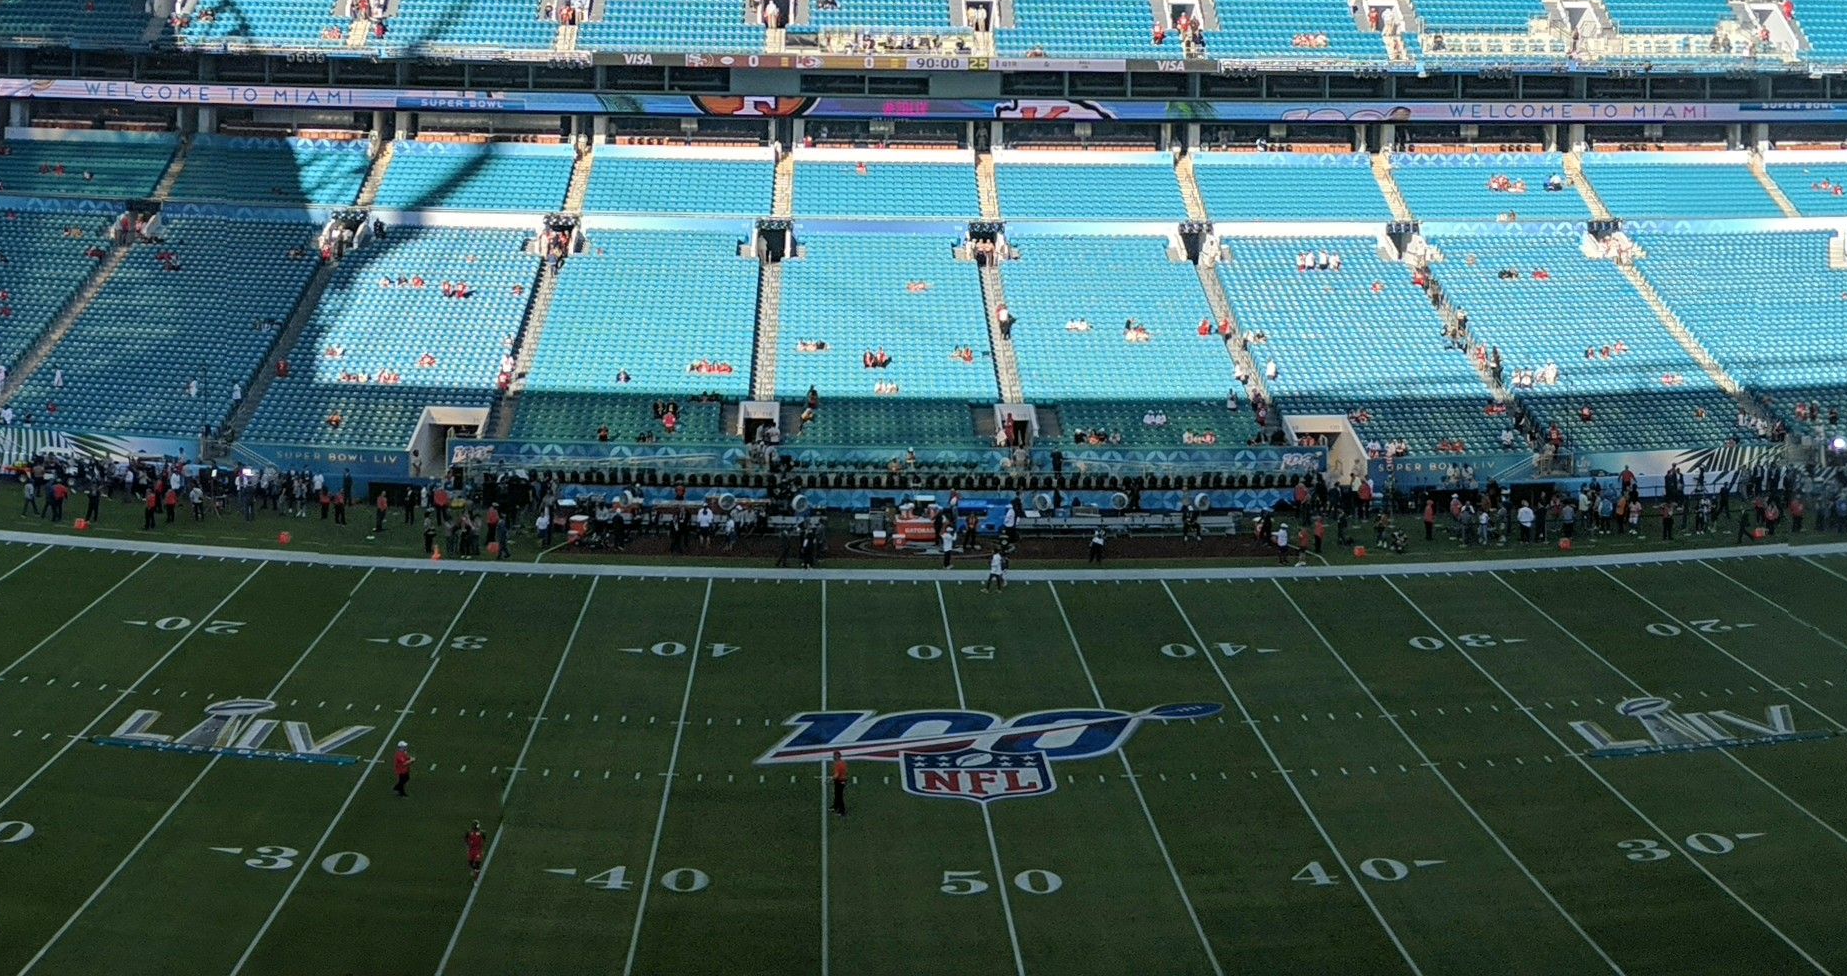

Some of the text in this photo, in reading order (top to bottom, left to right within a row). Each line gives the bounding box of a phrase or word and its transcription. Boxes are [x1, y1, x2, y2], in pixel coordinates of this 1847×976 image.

[623, 54, 653, 65] VISA
[917, 57, 959, 69] 90:00
[1157, 60, 1186, 71] VISA
[83, 80, 353, 105] WELCOME TO MIAMI
[1449, 104, 1707, 119] WELCOME TO MIAMI
[110, 698, 376, 755] LIV
[754, 709, 1141, 762] 100
[922, 770, 1037, 795] NFL
[1618, 833, 1735, 862] 30
[245, 846, 370, 875] 30
[1291, 856, 1408, 887] 40
[585, 865, 709, 892] 40
[940, 869, 1062, 894] 50
